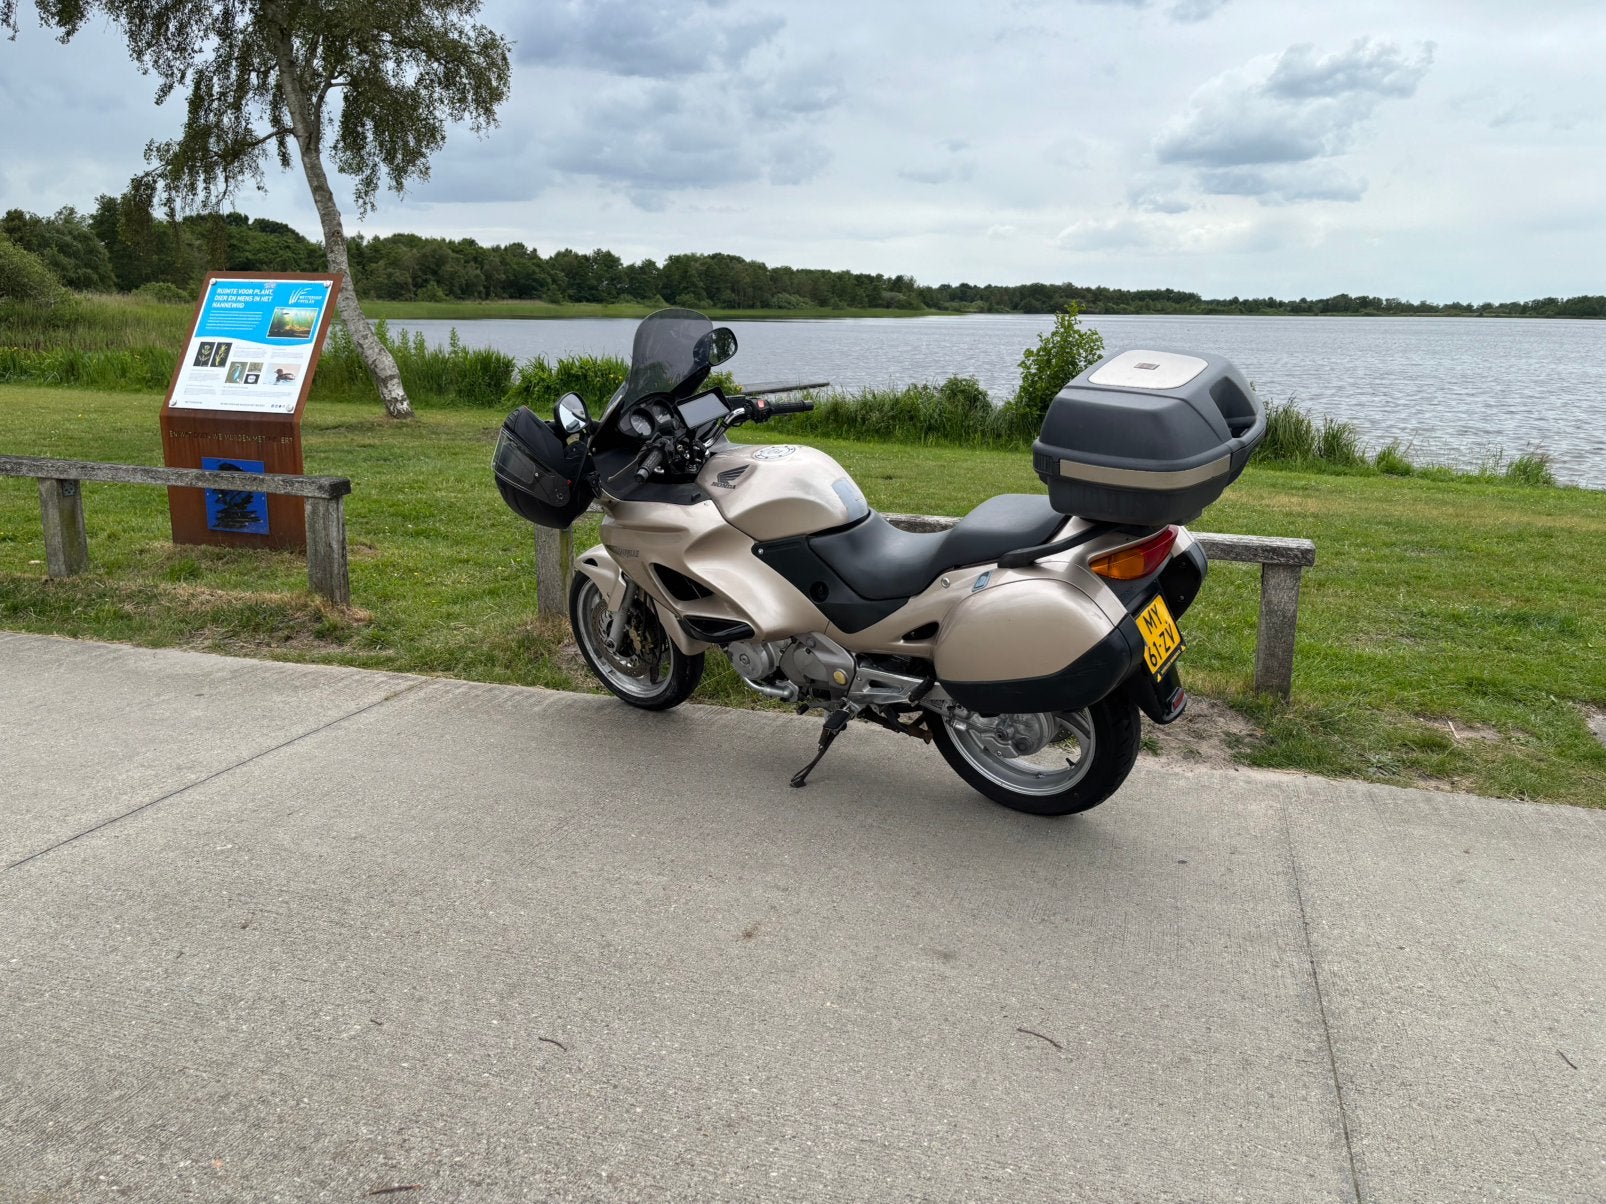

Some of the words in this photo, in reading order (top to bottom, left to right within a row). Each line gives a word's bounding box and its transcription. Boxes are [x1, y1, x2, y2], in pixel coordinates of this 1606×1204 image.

[711, 481, 737, 490] HONDA
[1142, 603, 1162, 635] MY
[1147, 623, 1175, 668] 61-ZV
